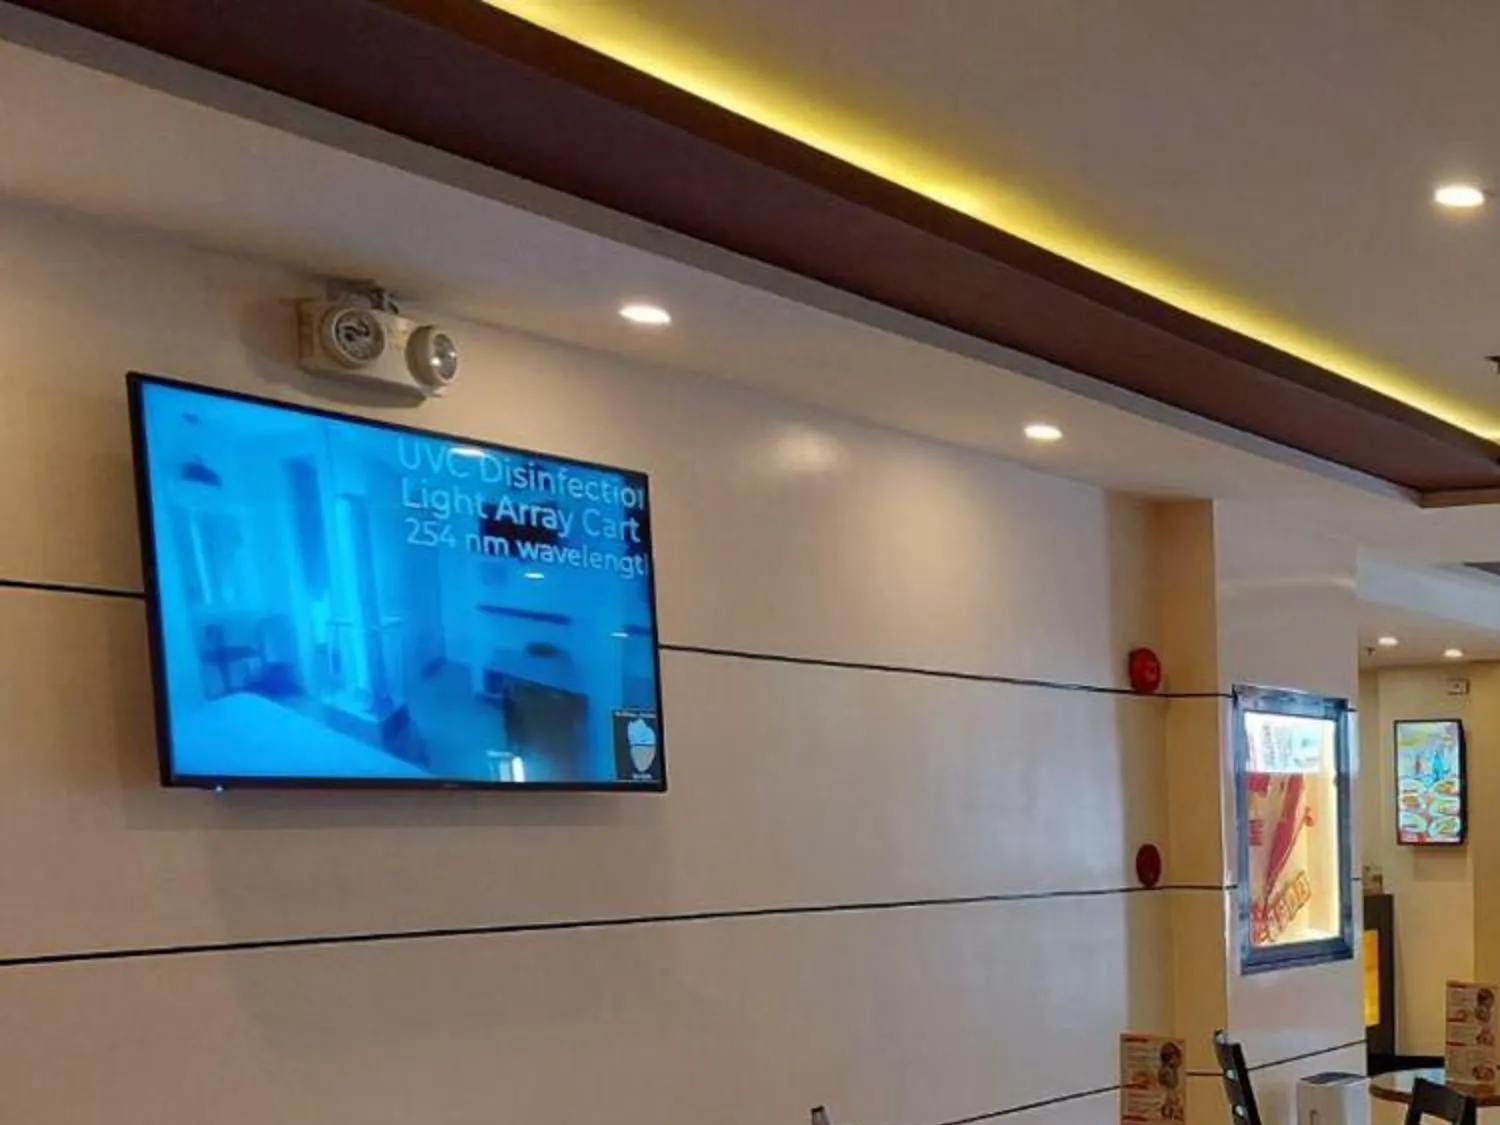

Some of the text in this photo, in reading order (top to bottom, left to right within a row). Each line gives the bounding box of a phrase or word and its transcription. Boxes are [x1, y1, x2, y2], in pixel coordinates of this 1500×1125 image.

[399, 437, 469, 478] UVC
[401, 477, 641, 543] Light Array Cart
[404, 517, 457, 548] 254
[465, 534, 510, 558] nm
